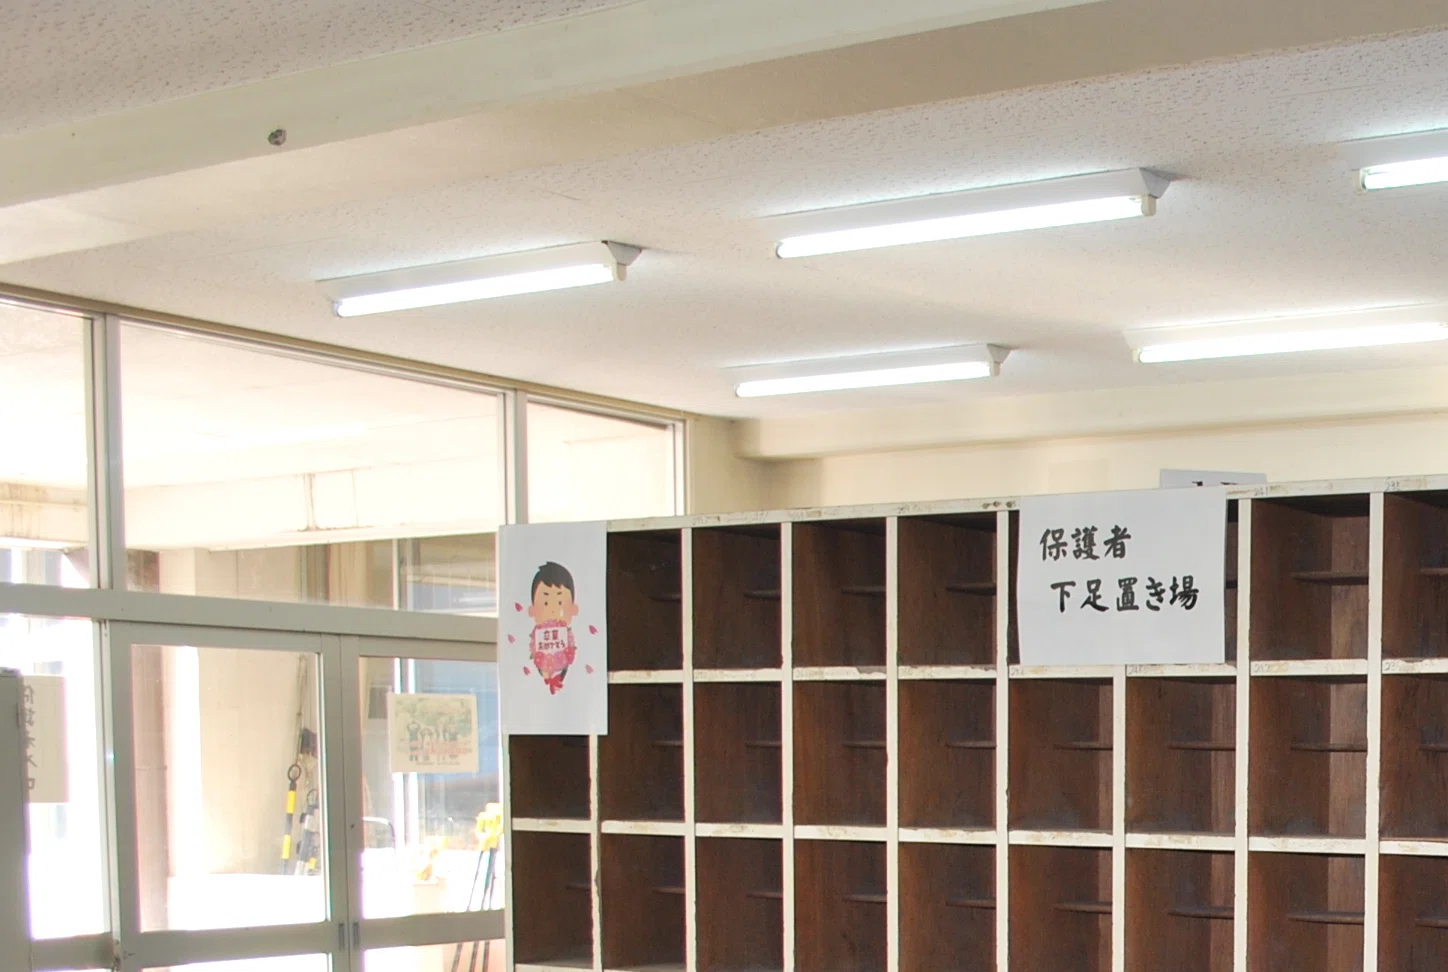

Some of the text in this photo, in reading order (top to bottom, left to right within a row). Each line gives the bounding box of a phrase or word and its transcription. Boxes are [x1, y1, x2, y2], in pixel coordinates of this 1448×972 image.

[1040, 525, 1131, 561] 保護者
[1050, 575, 1199, 613] 下足置き場
